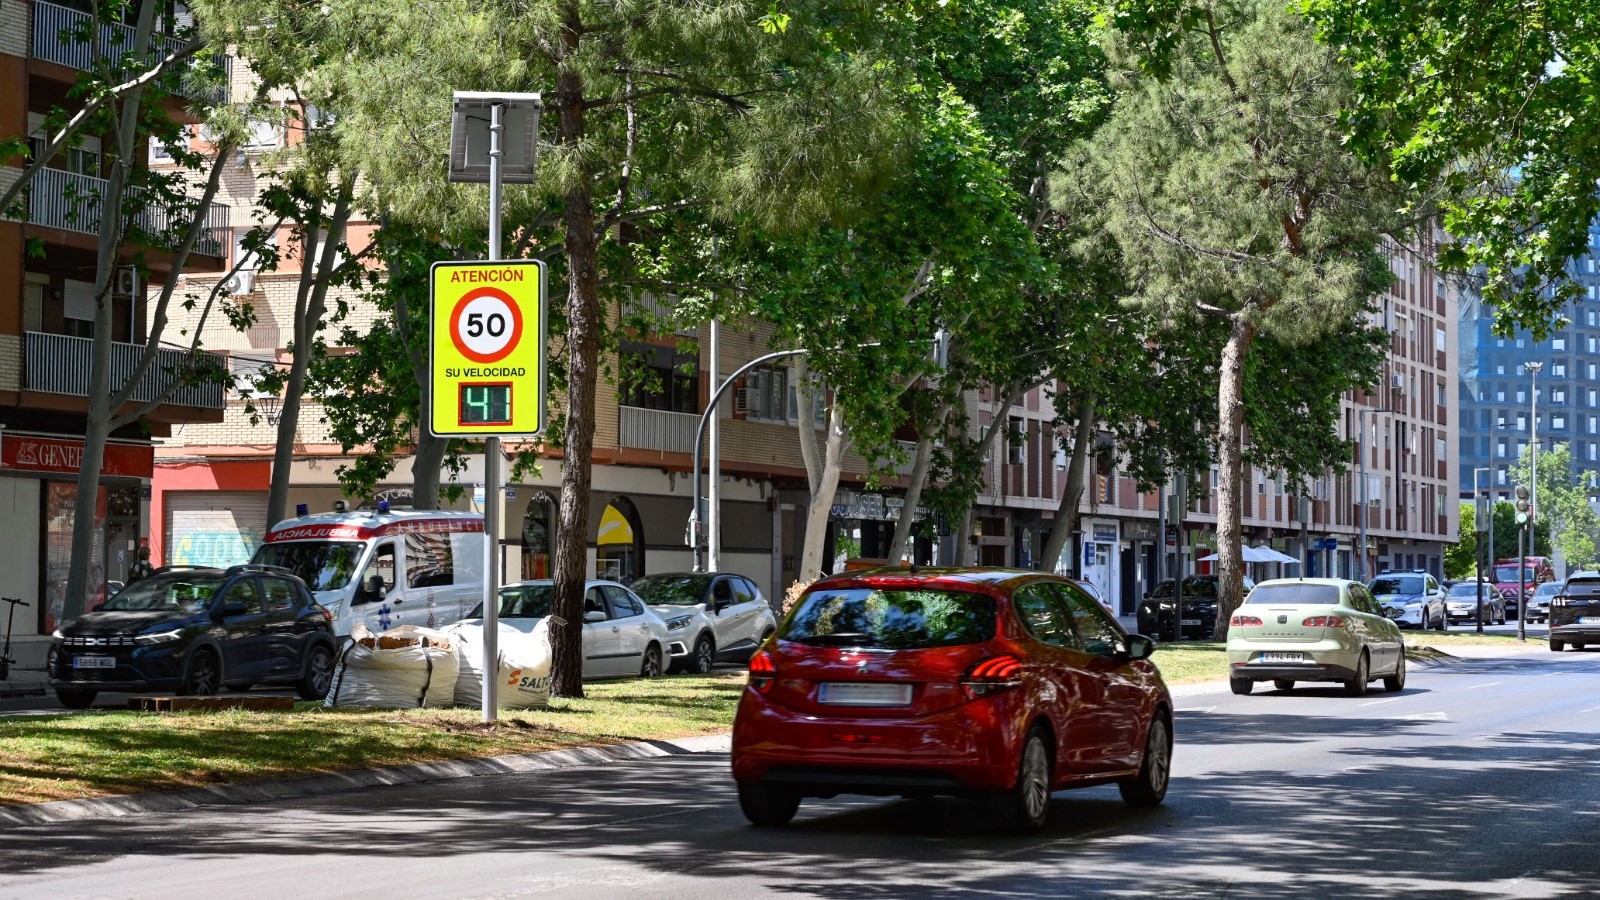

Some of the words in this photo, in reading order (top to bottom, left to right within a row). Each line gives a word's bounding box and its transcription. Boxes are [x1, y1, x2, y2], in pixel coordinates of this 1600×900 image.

[451, 266, 523, 282] ATENCIÓN
[467, 313, 506, 337] 50
[445, 368, 461, 378] SU
[463, 367, 526, 378] VELOCIDAD
[466, 387, 511, 421] 41
